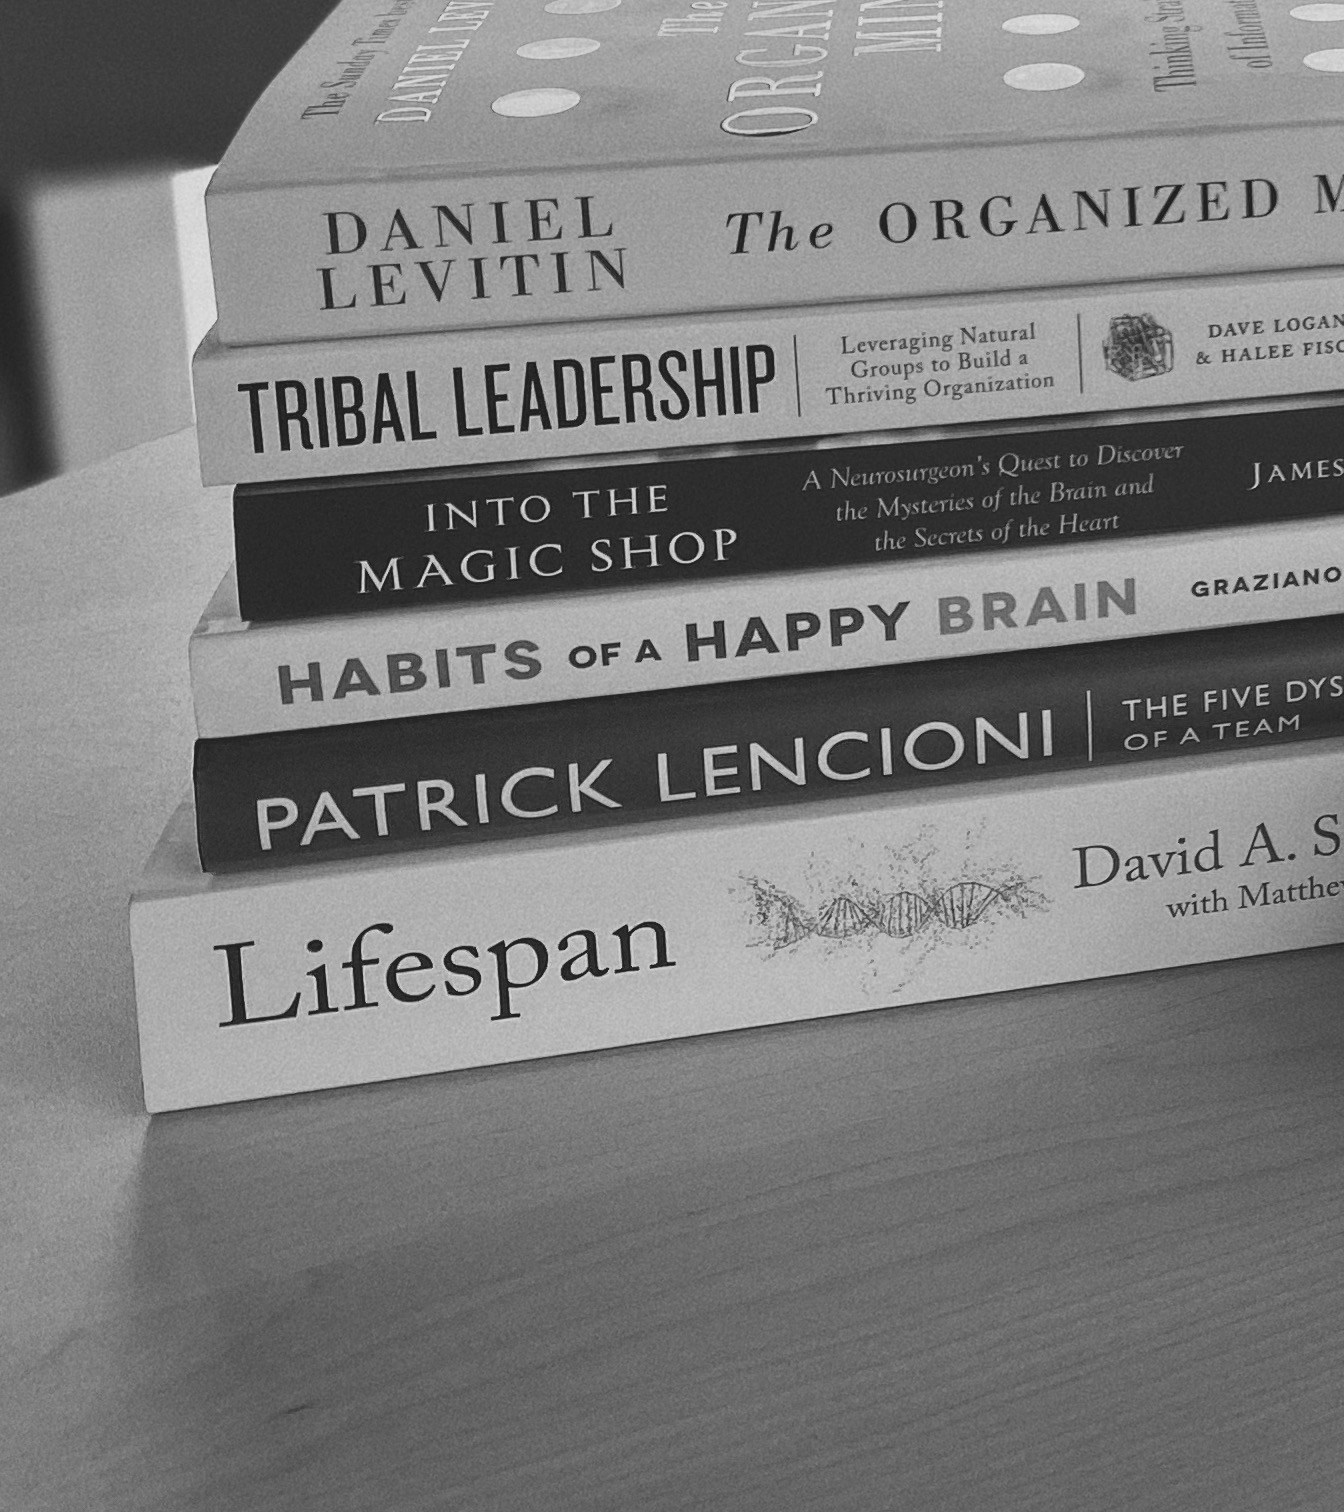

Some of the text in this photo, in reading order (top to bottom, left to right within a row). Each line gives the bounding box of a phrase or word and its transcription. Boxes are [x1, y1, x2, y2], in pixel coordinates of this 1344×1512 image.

[352, 19, 401, 46] Times
[657, 0, 728, 37] The
[320, 49, 389, 88] Sunday
[1149, 25, 1203, 92] Thinking
[1229, 55, 1273, 68] of
[374, 38, 470, 126] DANIEL
[301, 92, 350, 119] The
[322, 196, 614, 256] DANIEL
[725, 211, 834, 255] The
[878, 178, 1280, 245] ORGANIZED
[317, 247, 628, 310] LEVITIN
[841, 322, 1036, 356] Leveraging Natural
[1207, 319, 1265, 340] DAVE
[850, 349, 1029, 381] Groups to Build a
[1195, 350, 1212, 366] &
[1220, 342, 1295, 364] HALEE
[237, 343, 776, 453] TRIBAL LEADERSHIP
[825, 372, 1055, 406] Thriving Organization
[802, 442, 1185, 491] A Neurosurgeon's Quest to Discover
[1246, 457, 1344, 491] JAMES
[424, 484, 669, 533] INTO THE
[836, 473, 1155, 522] the Mysteries of the Brain and
[874, 512, 1120, 552] the Secrets of the Heart
[356, 527, 740, 594] MAGIC SHOP
[1191, 566, 1342, 599] GRAZIANO
[278, 576, 1139, 706] HABITS OF A HAPPY BRAIN
[1121, 693, 1187, 723] THE
[1204, 683, 1271, 714] FIVE
[1123, 715, 1300, 752] OF A TEAM
[255, 709, 1055, 851] PATRICK LENCIONI
[1072, 828, 1224, 890] David
[1238, 822, 1298, 870] A.
[1166, 888, 1229, 920] with
[212, 919, 677, 1028] Lifespan
